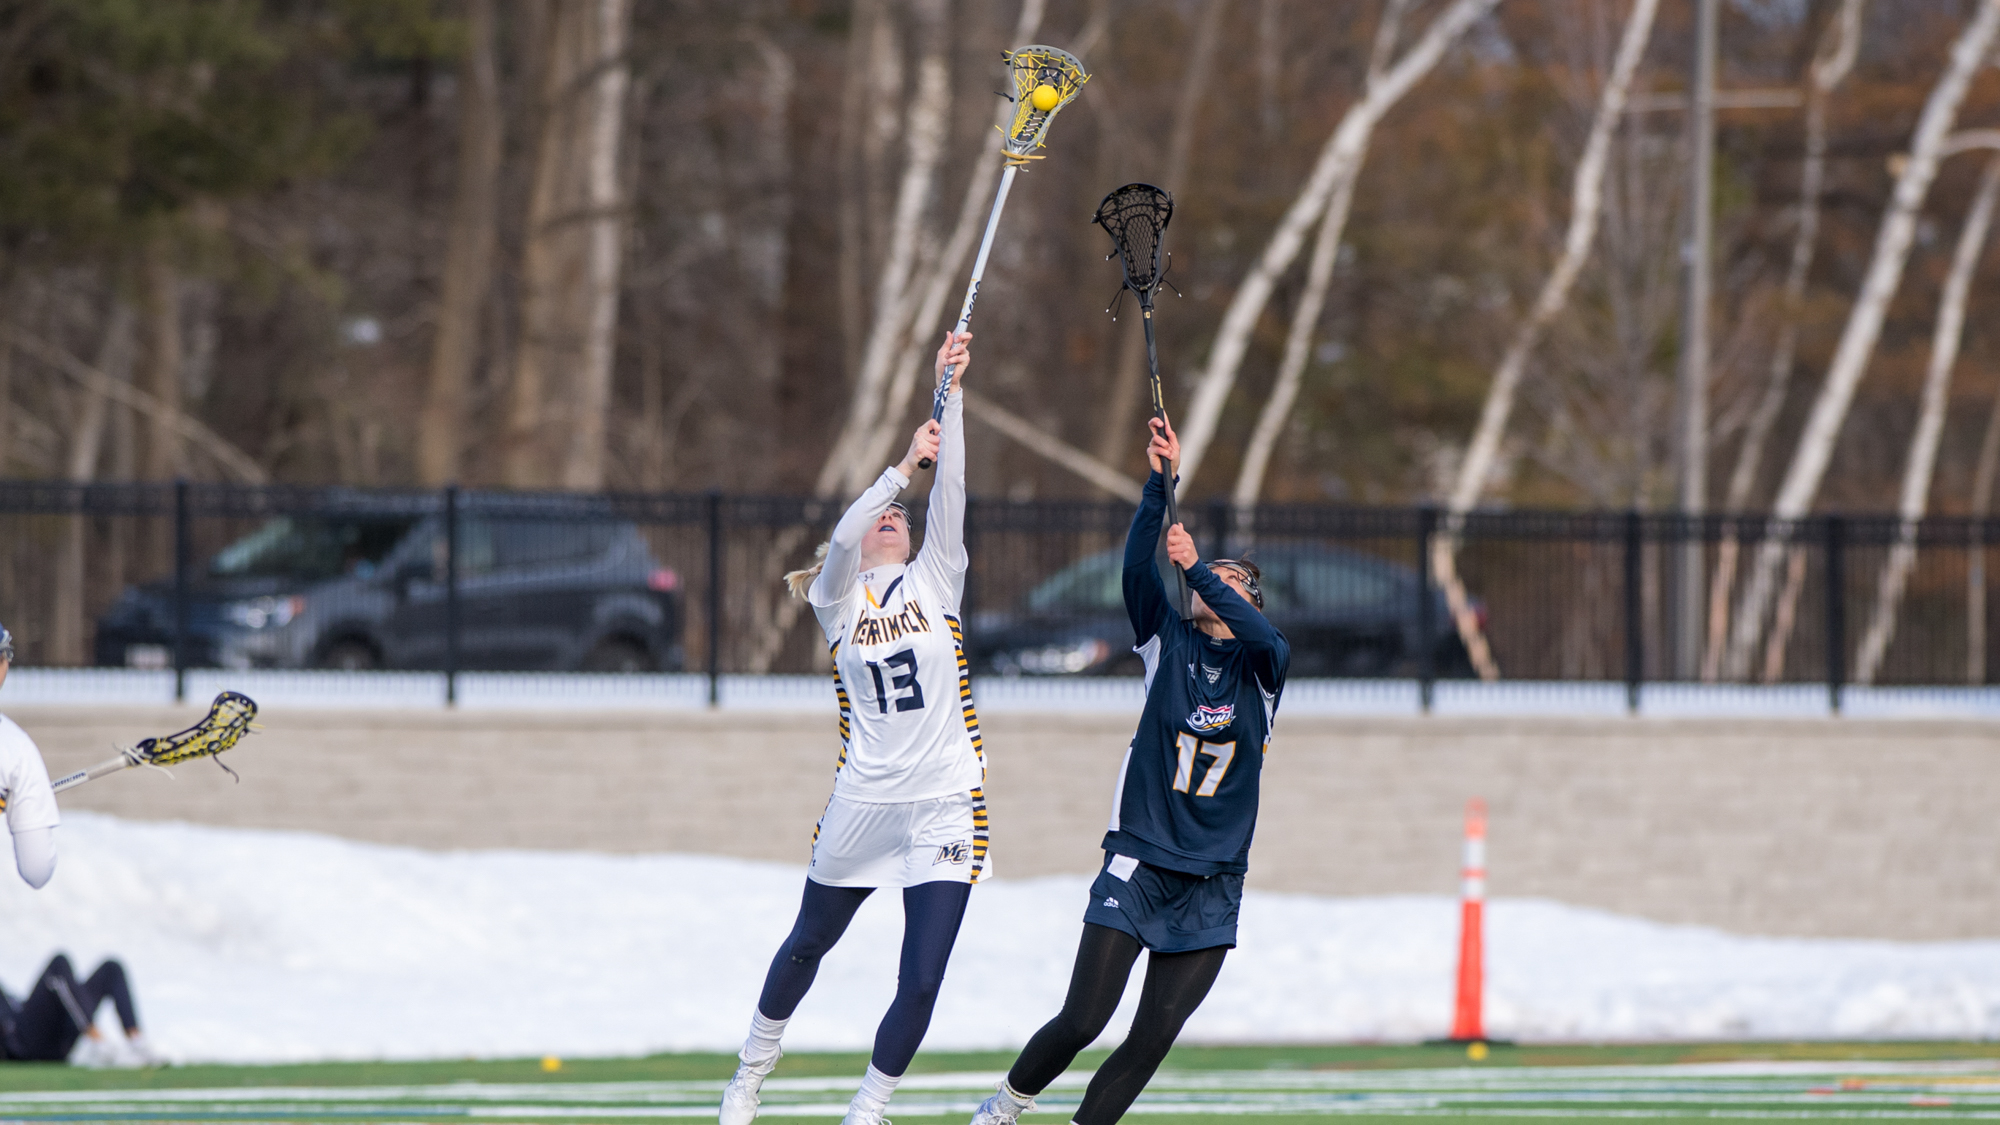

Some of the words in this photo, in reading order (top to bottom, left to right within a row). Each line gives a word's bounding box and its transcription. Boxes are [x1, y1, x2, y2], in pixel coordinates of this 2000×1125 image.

[865, 648, 925, 714] 13
[1172, 730, 1236, 797] 17
[933, 840, 971, 865] MC
